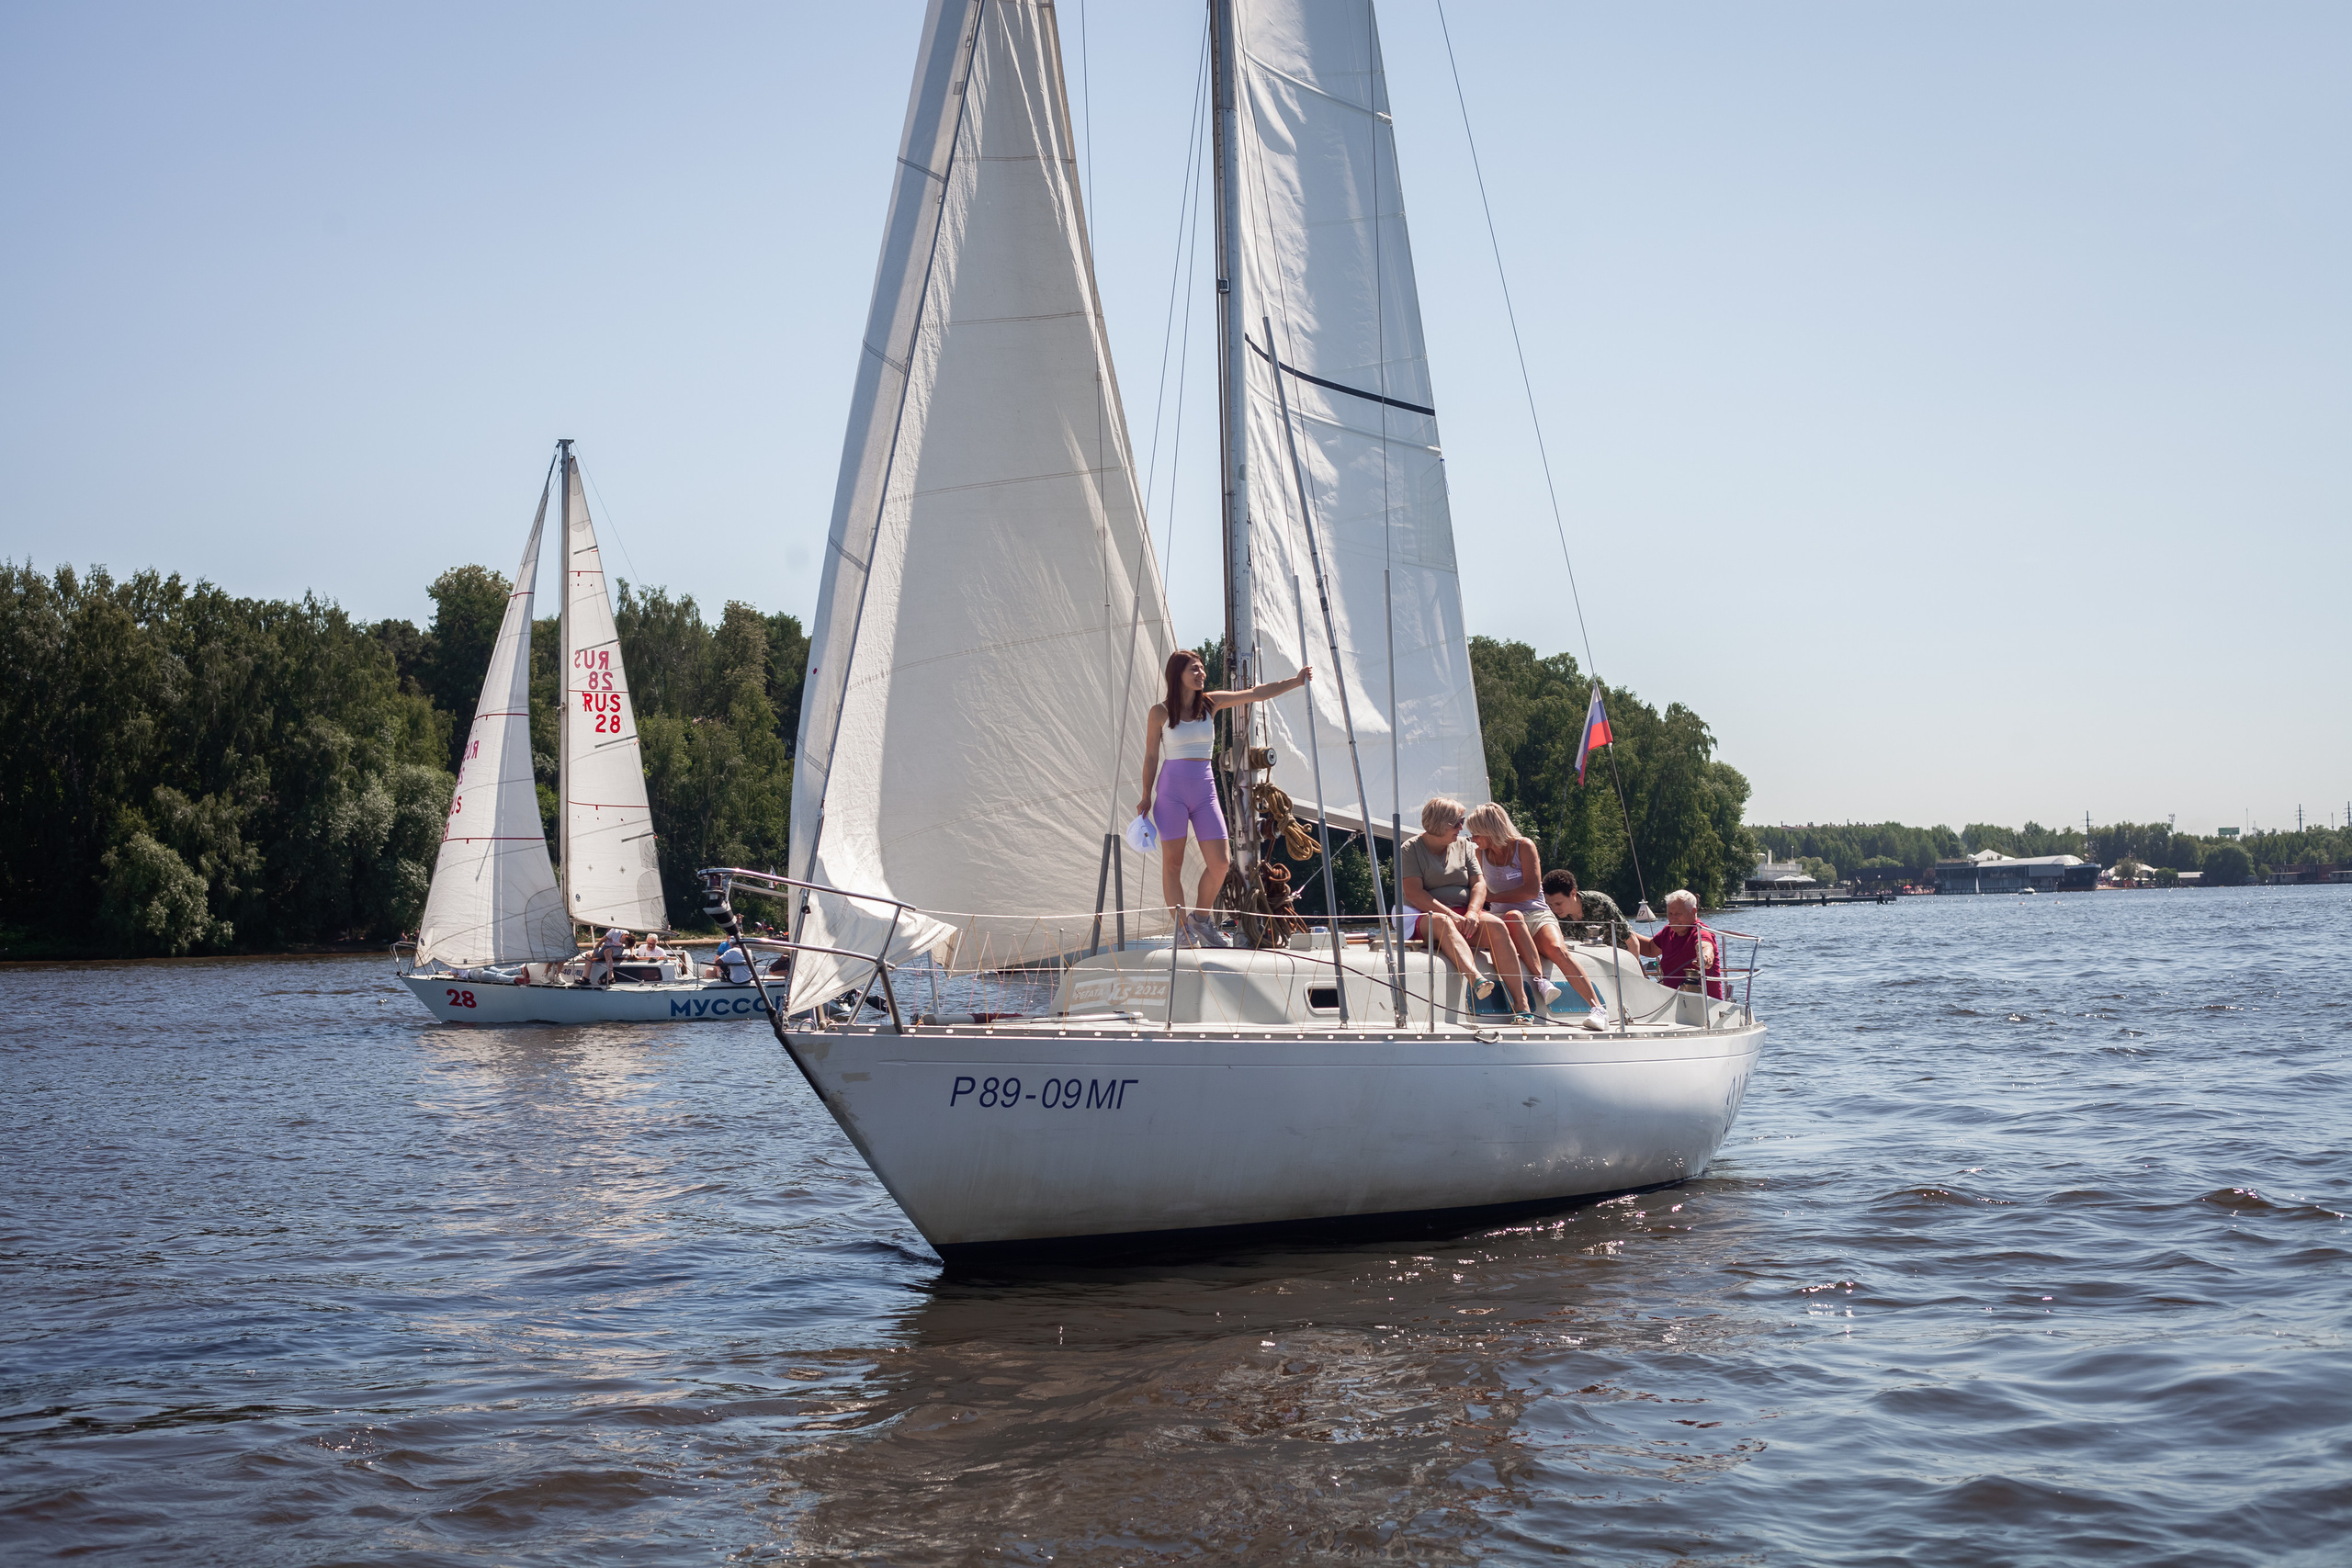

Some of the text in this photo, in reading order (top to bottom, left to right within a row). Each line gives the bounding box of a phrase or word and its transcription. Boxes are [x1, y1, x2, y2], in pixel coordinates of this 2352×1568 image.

[583, 693, 621, 713] RUS
[595, 714, 621, 734] 28
[446, 988, 477, 1009] 28
[1134, 985, 1167, 996] 2014
